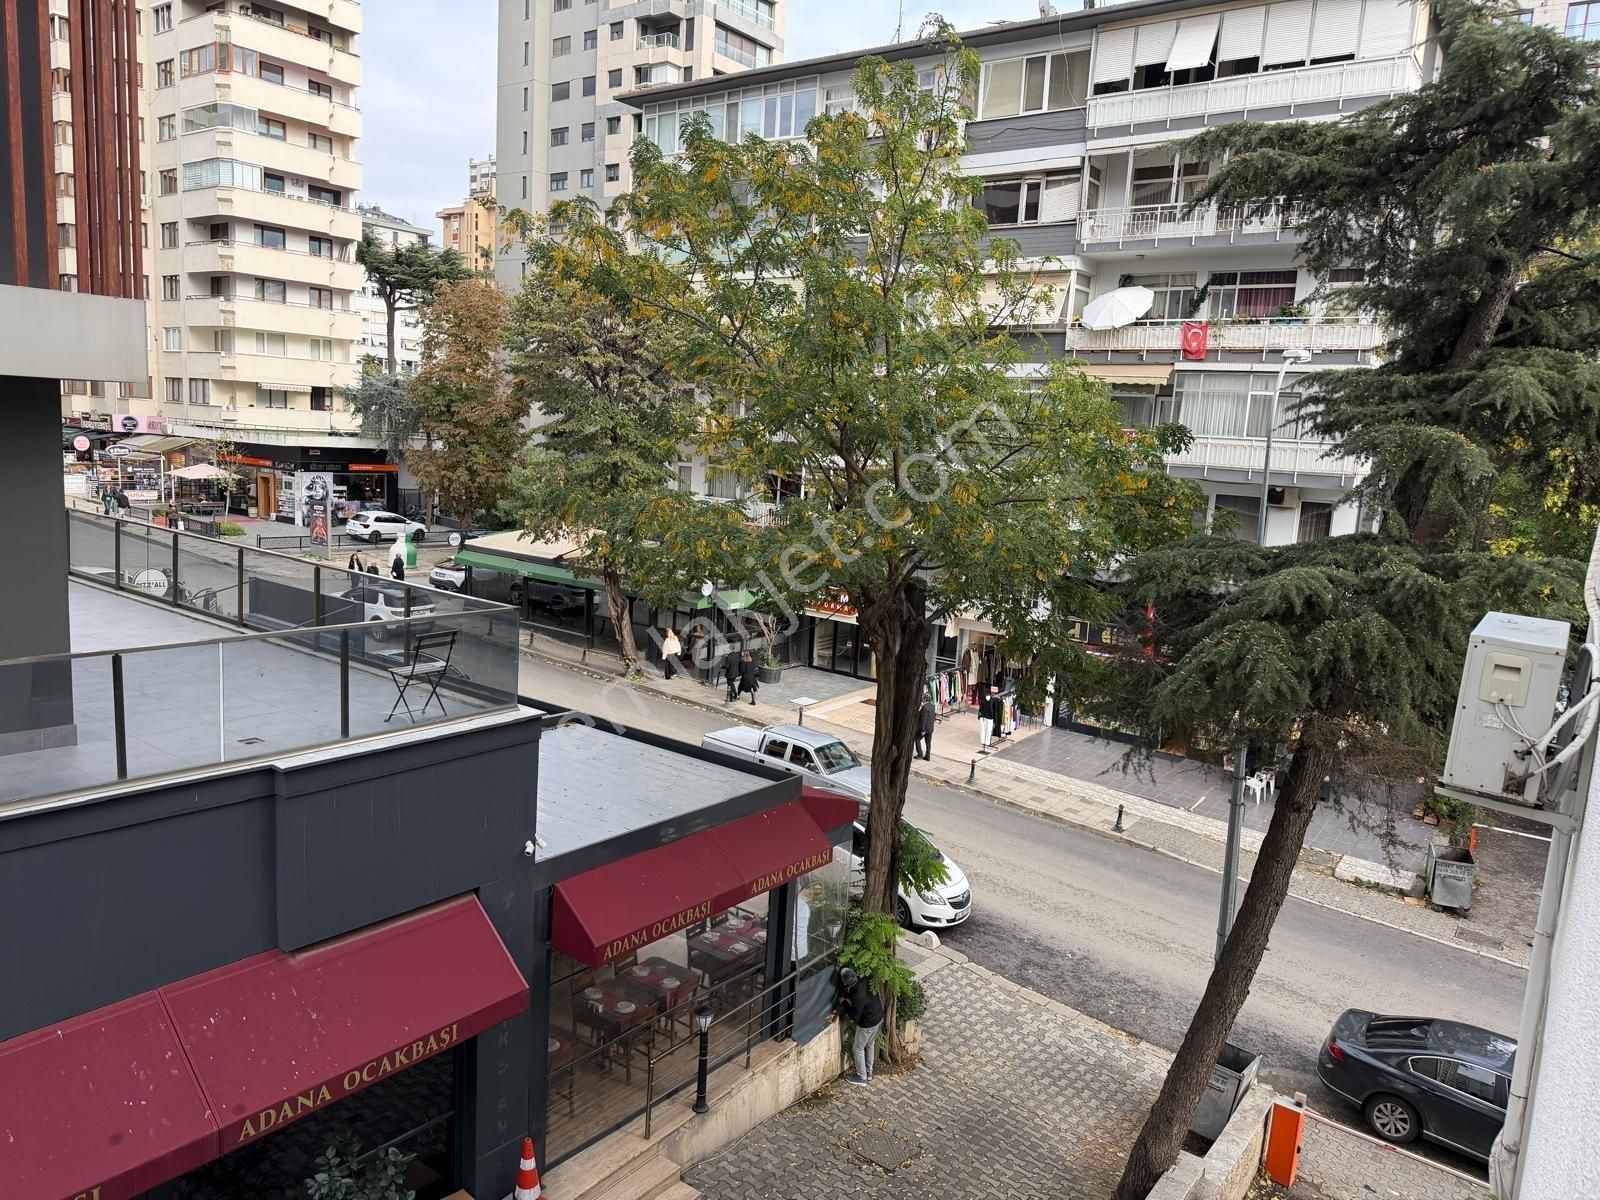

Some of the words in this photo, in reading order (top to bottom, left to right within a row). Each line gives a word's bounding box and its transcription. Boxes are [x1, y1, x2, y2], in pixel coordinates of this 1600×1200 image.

[751, 869, 784, 894] ADANA
[786, 849, 831, 878] OCAKBAŞI
[603, 929, 648, 961] ADANA
[652, 900, 712, 938] OCAKBAŞI
[238, 1084, 333, 1142] ADANA
[342, 1023, 458, 1091] OCAKBAŞI
